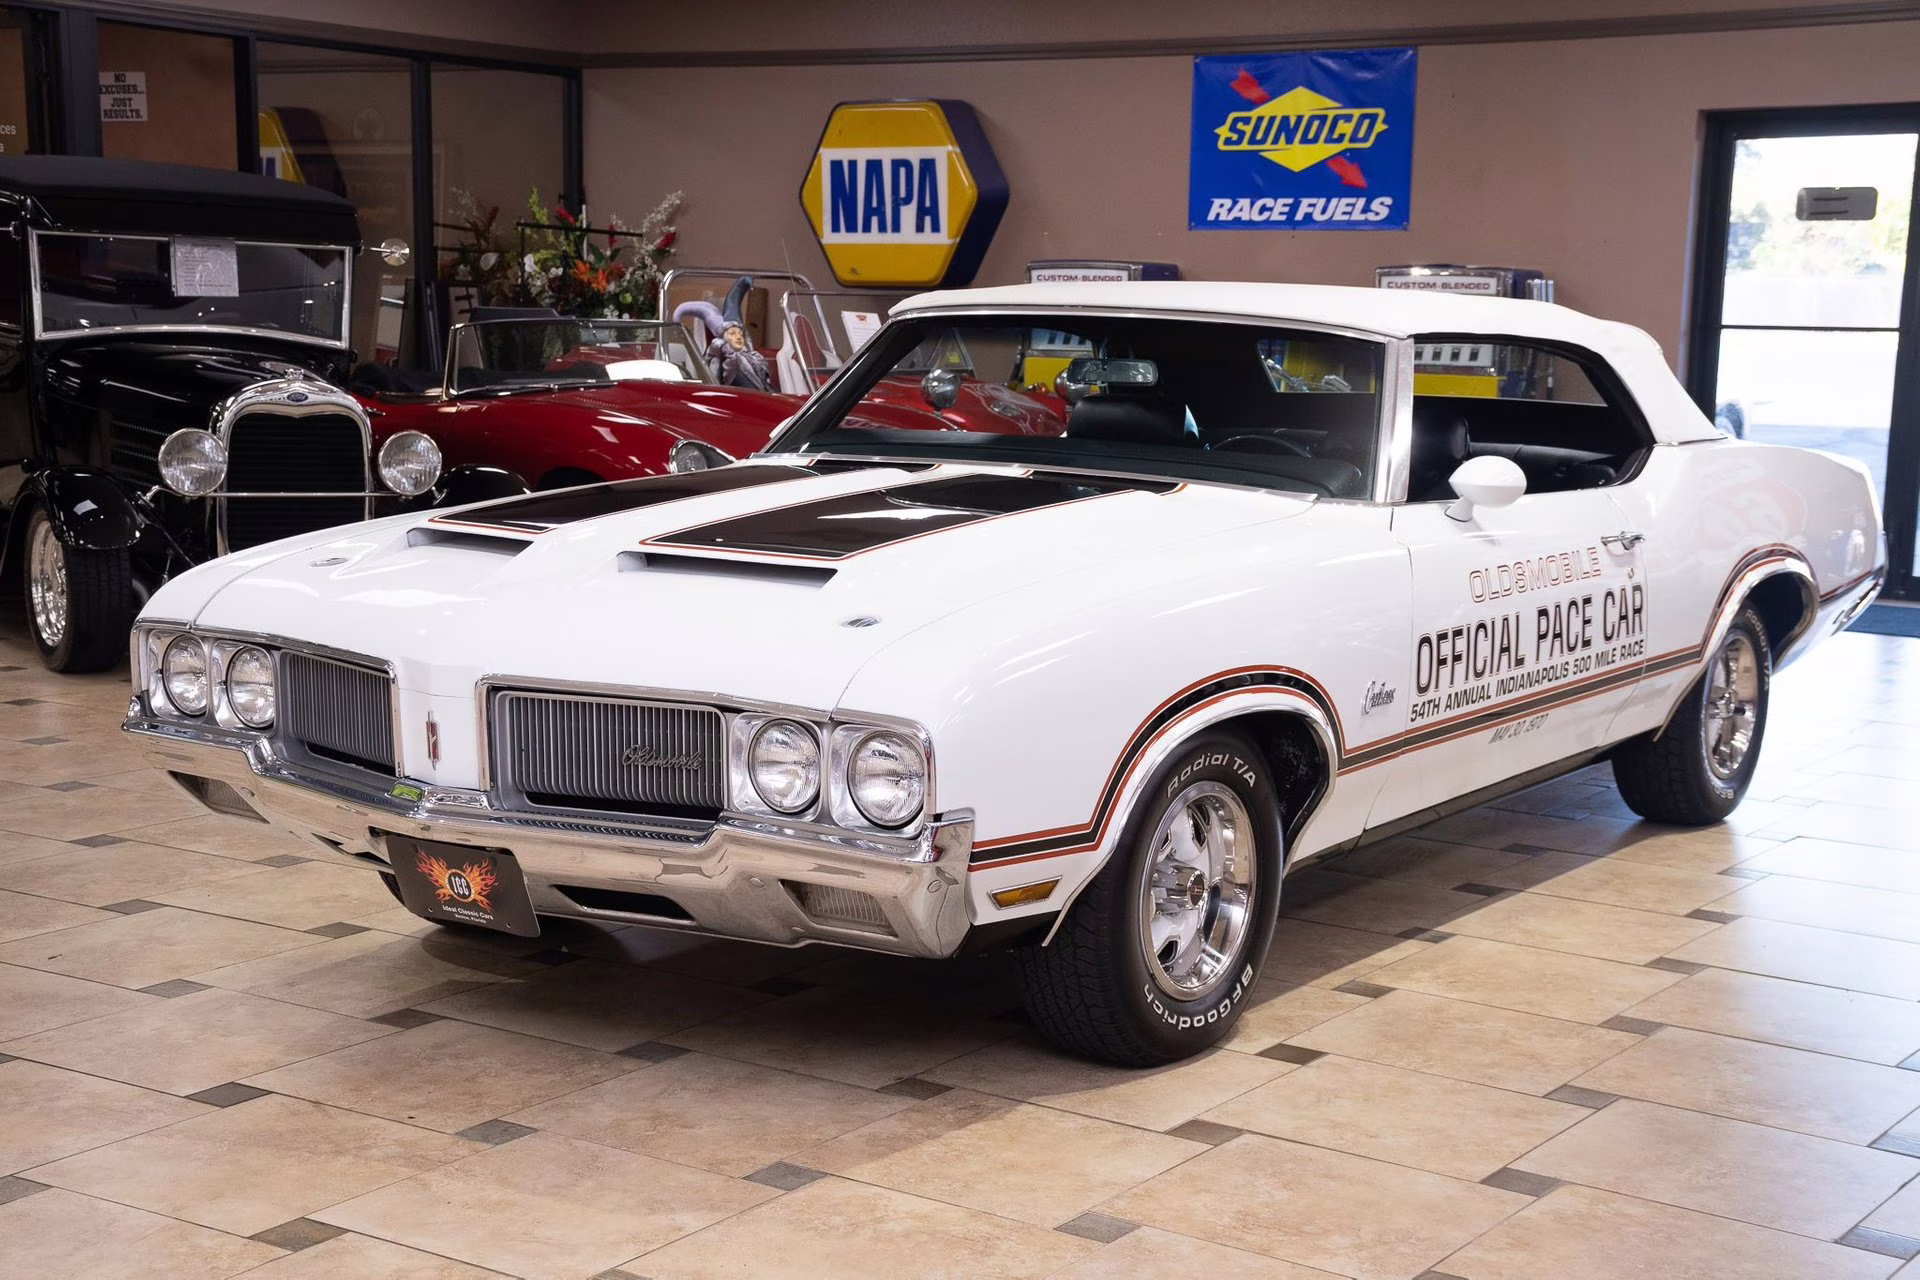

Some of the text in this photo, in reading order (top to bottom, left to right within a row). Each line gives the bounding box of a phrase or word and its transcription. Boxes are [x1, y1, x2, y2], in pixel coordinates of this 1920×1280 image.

[114, 73, 127, 83] NO
[103, 108, 143, 119] RESULTS.
[111, 97, 133, 108] JUST
[1223, 113, 1379, 146] SUNOCO
[830, 158, 941, 233] NAPA
[1206, 196, 1393, 222] RACE FUELS
[1468, 546, 1602, 604] OLDSMOBILE
[1415, 581, 1645, 697] OFFICIAL PACE CAR
[1410, 639, 1645, 723] 54TH ANNUAL INDIANAPOLIS 500 MILE RACE
[1167, 753, 1256, 799] Radial T/A
[451, 876, 470, 896] ICC
[457, 907, 480, 918] Classic
[479, 911, 494, 921] Cars
[1143, 962, 1255, 1031] BFGoodrich
